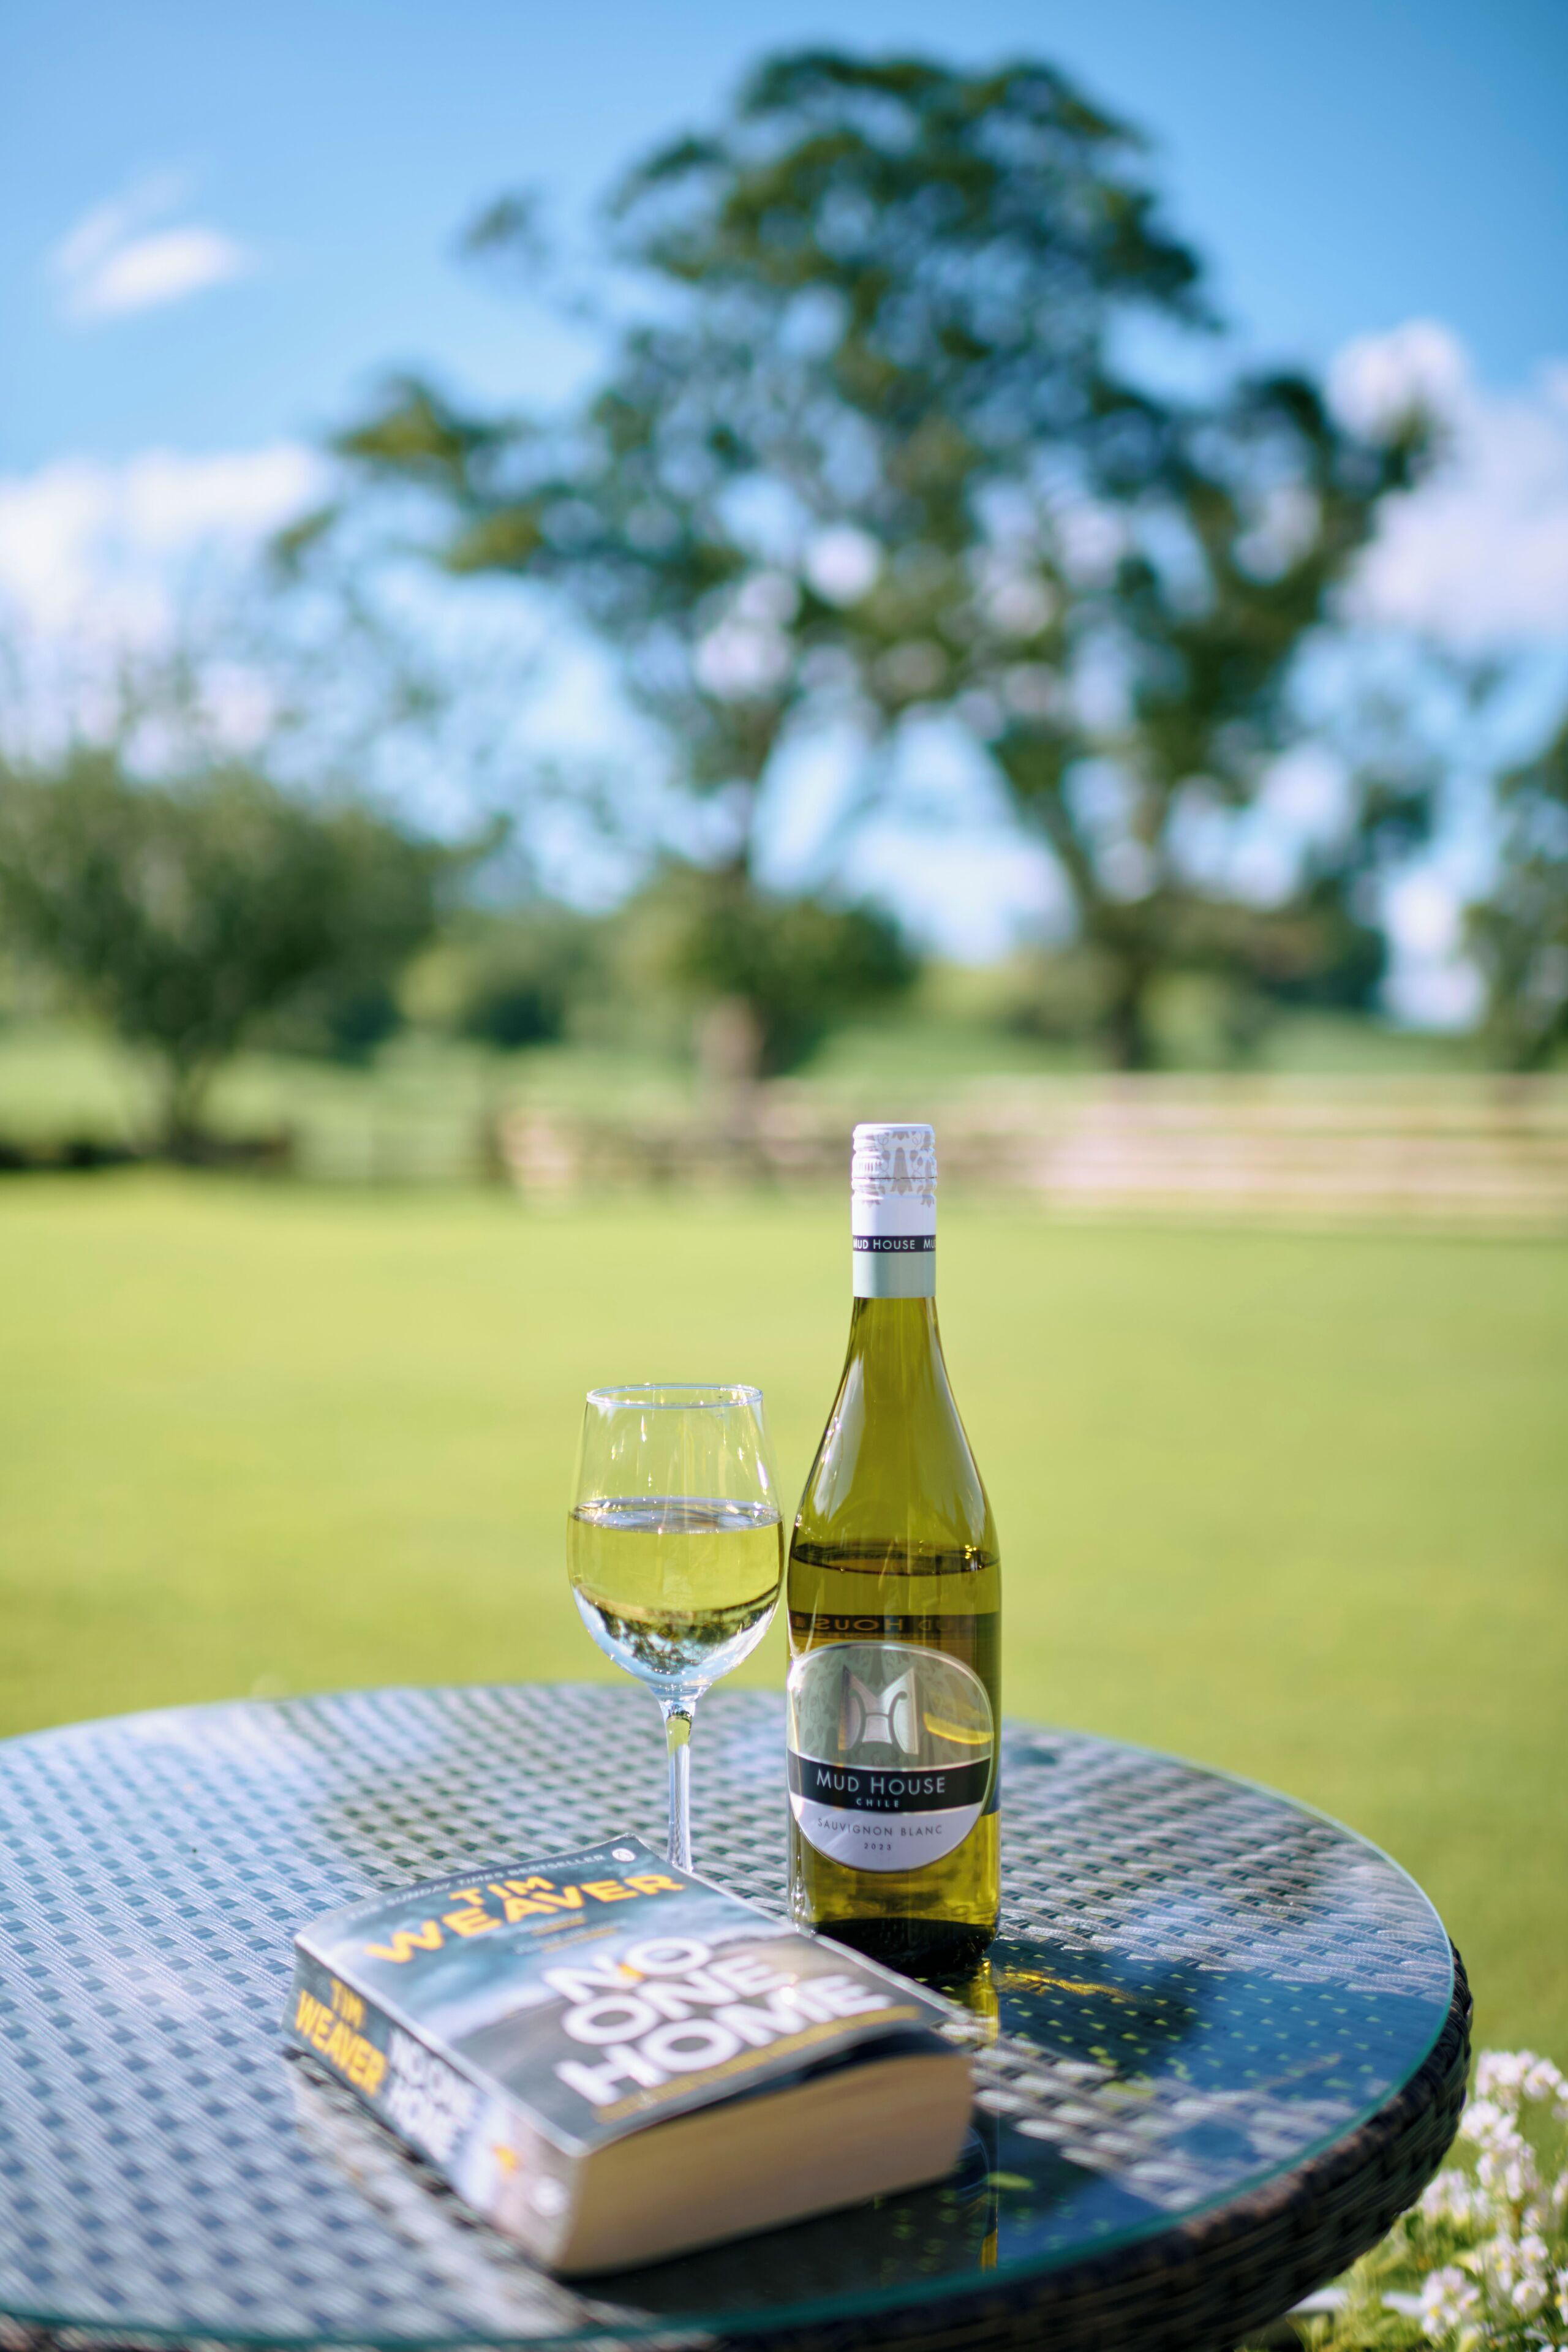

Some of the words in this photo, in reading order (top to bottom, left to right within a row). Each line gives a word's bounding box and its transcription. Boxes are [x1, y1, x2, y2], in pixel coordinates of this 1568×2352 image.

[853, 1238, 869, 1250] MUD
[873, 1238, 915, 1250] HOUSE
[923, 1238, 936, 1250] MU
[816, 1768, 859, 1792] MUD
[870, 1776, 946, 1796] HOUSE
[856, 1798, 900, 1808] CHILE
[817, 1817, 893, 1836] SAUVIGNON
[900, 1825, 943, 1837] BLANC
[864, 1842, 892, 1851] 2023
[385, 1882, 452, 1907] SUNDAY
[456, 1871, 505, 1887] TIMES
[448, 1875, 557, 1906] TIM
[364, 1874, 686, 1964] WEAVER
[541, 1936, 714, 2004] NO
[329, 1977, 366, 2031] TIM
[560, 1954, 798, 2046] ONE
[293, 1988, 390, 2098] WEAVER
[554, 1973, 897, 2108] HOME
